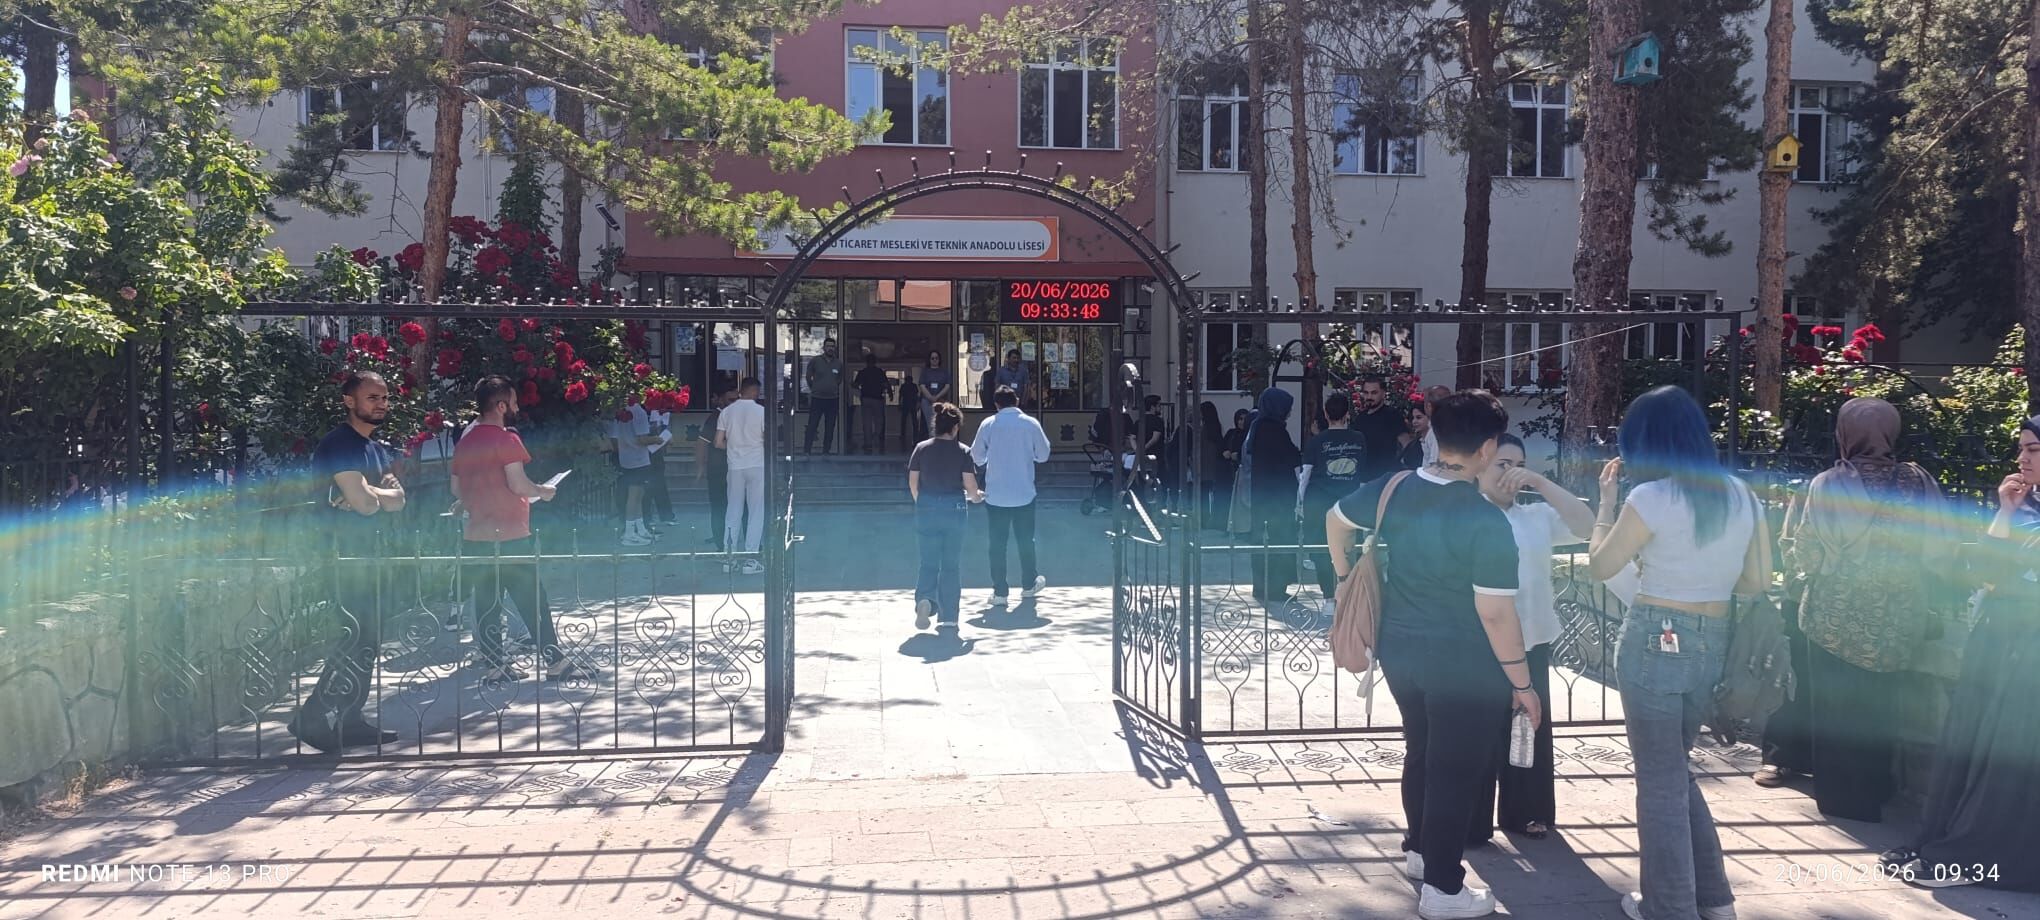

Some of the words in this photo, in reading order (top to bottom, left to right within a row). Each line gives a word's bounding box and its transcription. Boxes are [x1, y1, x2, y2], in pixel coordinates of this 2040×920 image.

[840, 237, 878, 249] TİCARET
[880, 238, 919, 249] MESLEKİ
[921, 239, 933, 250] VE
[934, 239, 968, 250] TEKNİK
[970, 240, 1016, 250] ANADOLU
[1018, 239, 1045, 251] LİSESİ
[1010, 281, 1110, 300] 20/06/2026
[1020, 303, 1100, 319] 09:33:48
